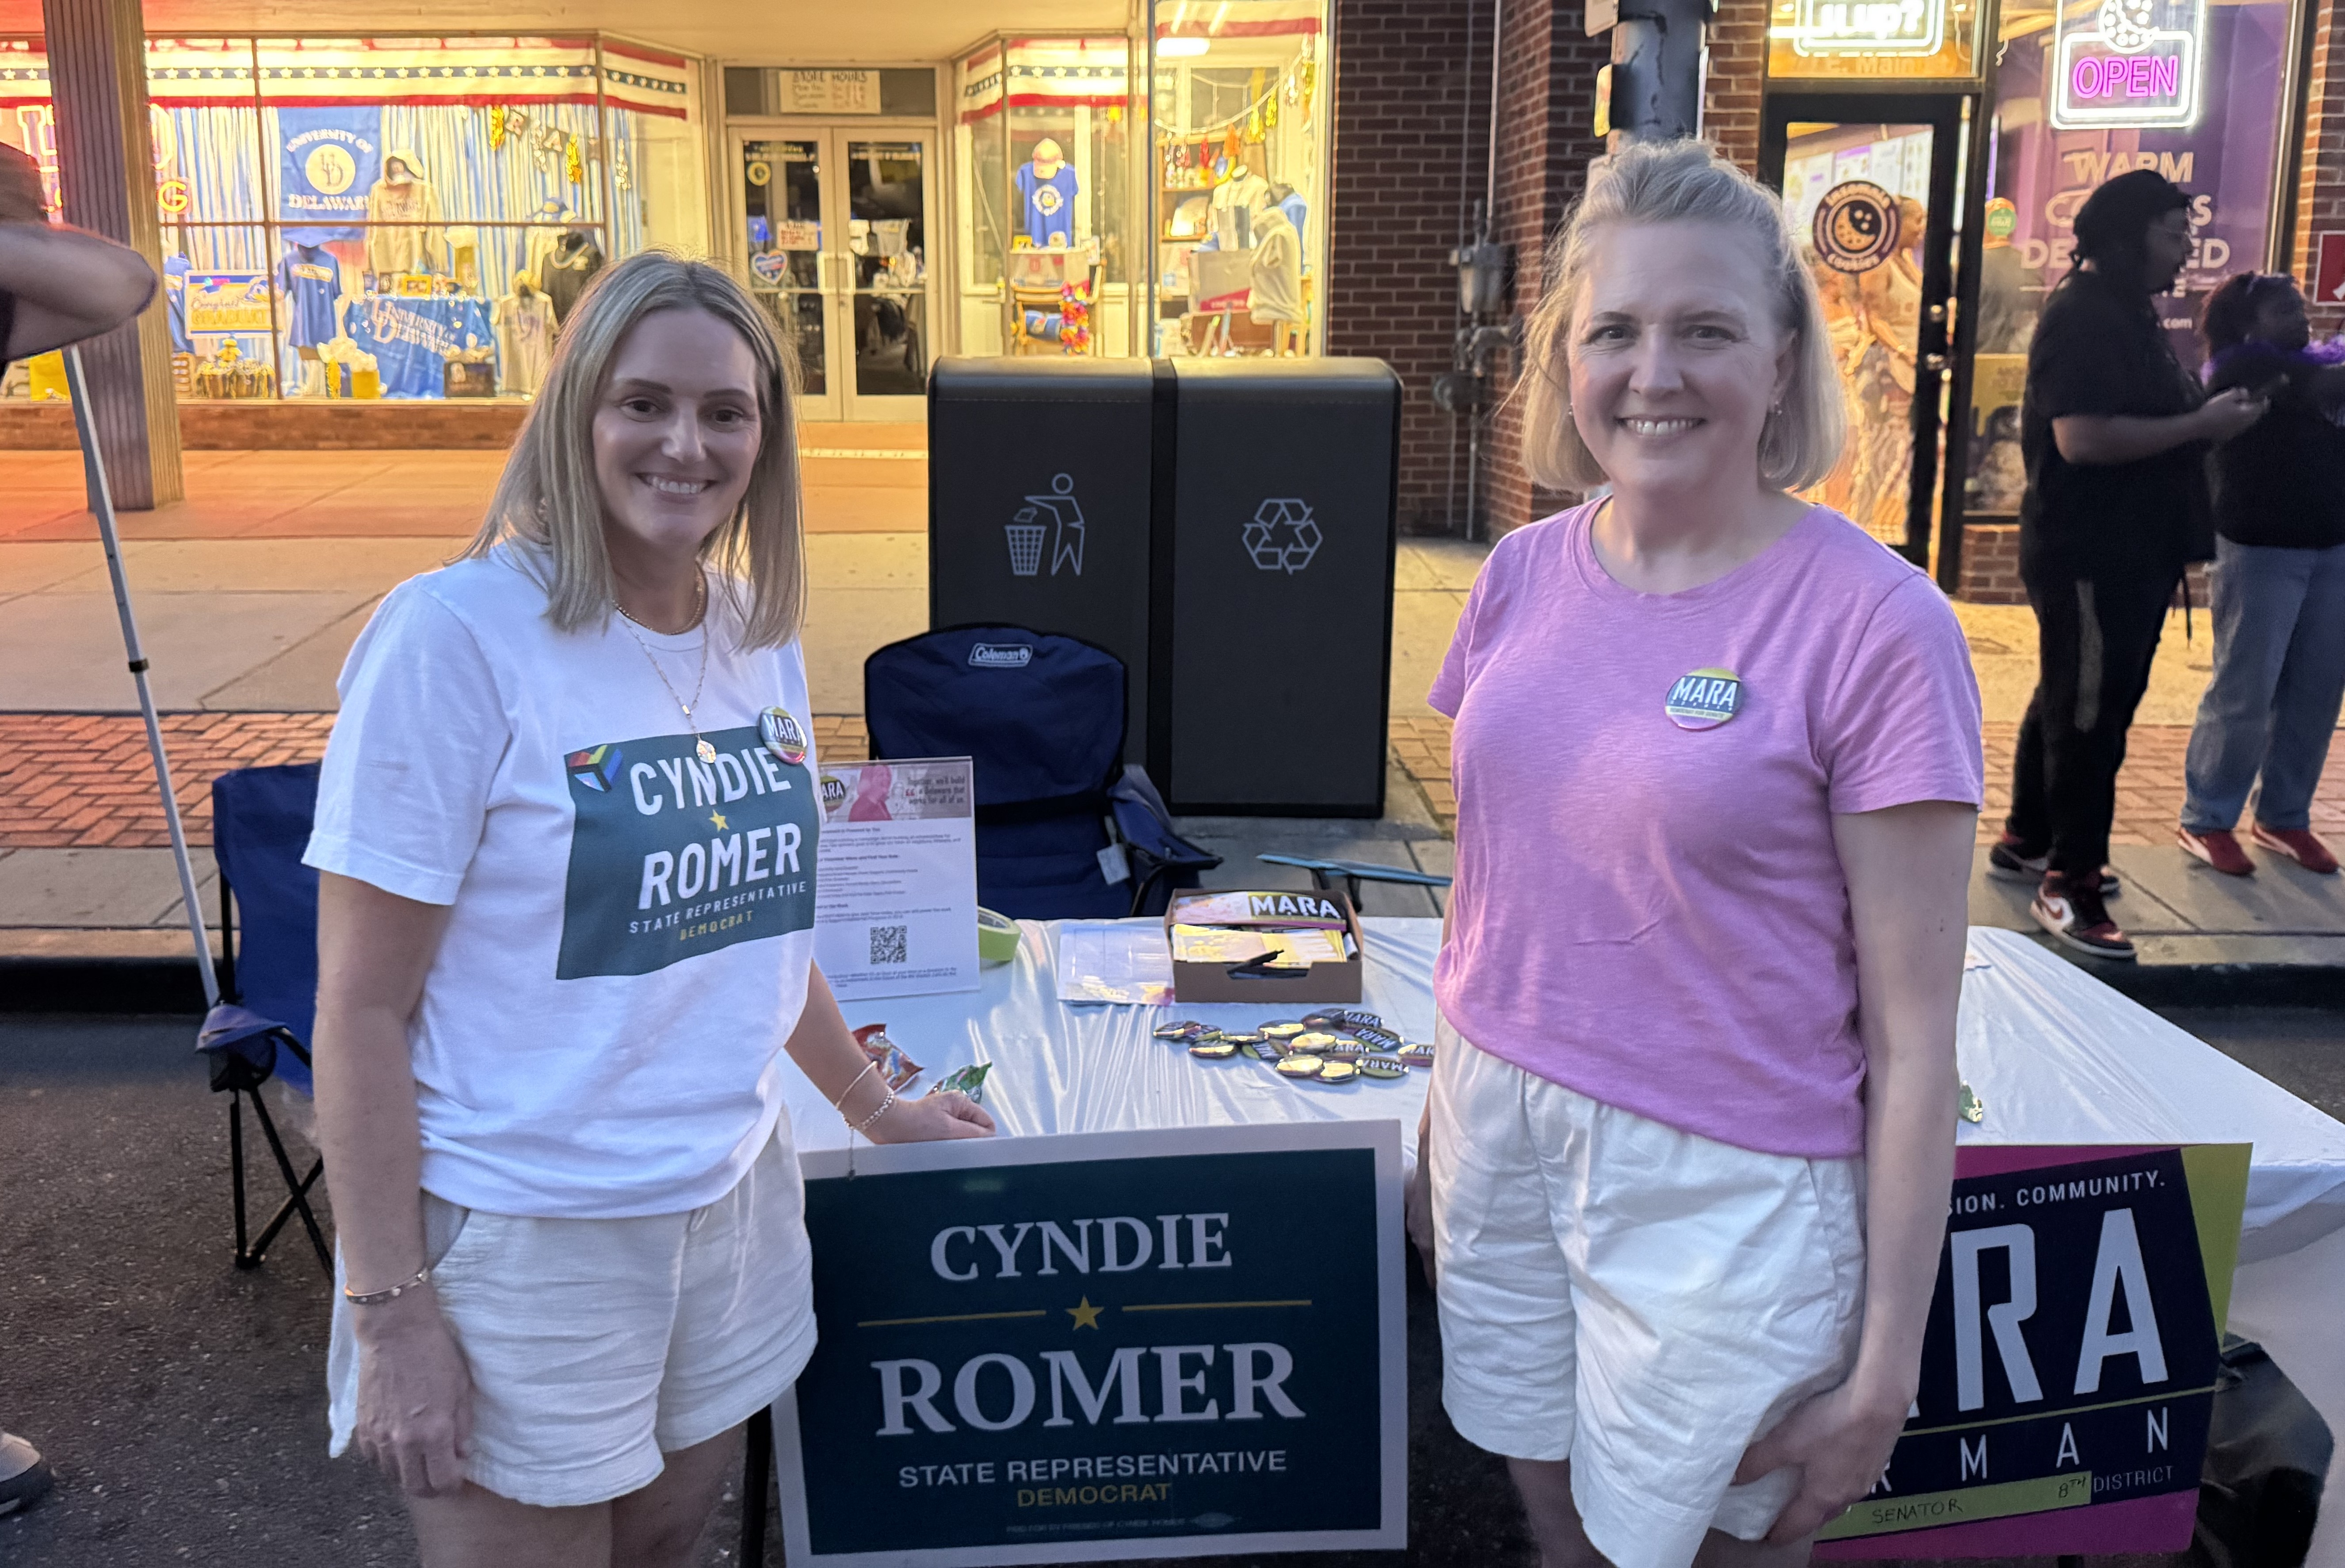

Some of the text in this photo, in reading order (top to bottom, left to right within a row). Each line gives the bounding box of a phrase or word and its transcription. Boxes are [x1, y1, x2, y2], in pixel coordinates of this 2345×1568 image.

[2072, 55, 2179, 99] OPEN
[286, 129, 356, 153] UNIVERSITY
[288, 193, 370, 211] DELAWAR
[975, 647, 1019, 660] Coleman
[1672, 677, 1738, 707] MARA
[630, 746, 791, 816] CYNDIE
[821, 782, 844, 797] ARA
[638, 823, 802, 910] ROMER
[628, 911, 680, 934] STATE
[685, 881, 807, 920] REPRESENTATIVE
[1251, 895, 1341, 919] MARA
[680, 910, 754, 941] DEMOCRAT
[1948, 1169, 2166, 1216] ION. COMMUNITY.
[930, 1212, 1233, 1282] CYNDIE
[1906, 1207, 2169, 1418] RA
[870, 1341, 1307, 1437] ROMER
[899, 1450, 1287, 1488] STATE REPRESENTATIVE
[2093, 1465, 2173, 1493] DISTRICT
[1017, 1483, 1172, 1507] DEMOCRAT
[1872, 1498, 1963, 1524] SENATOR
